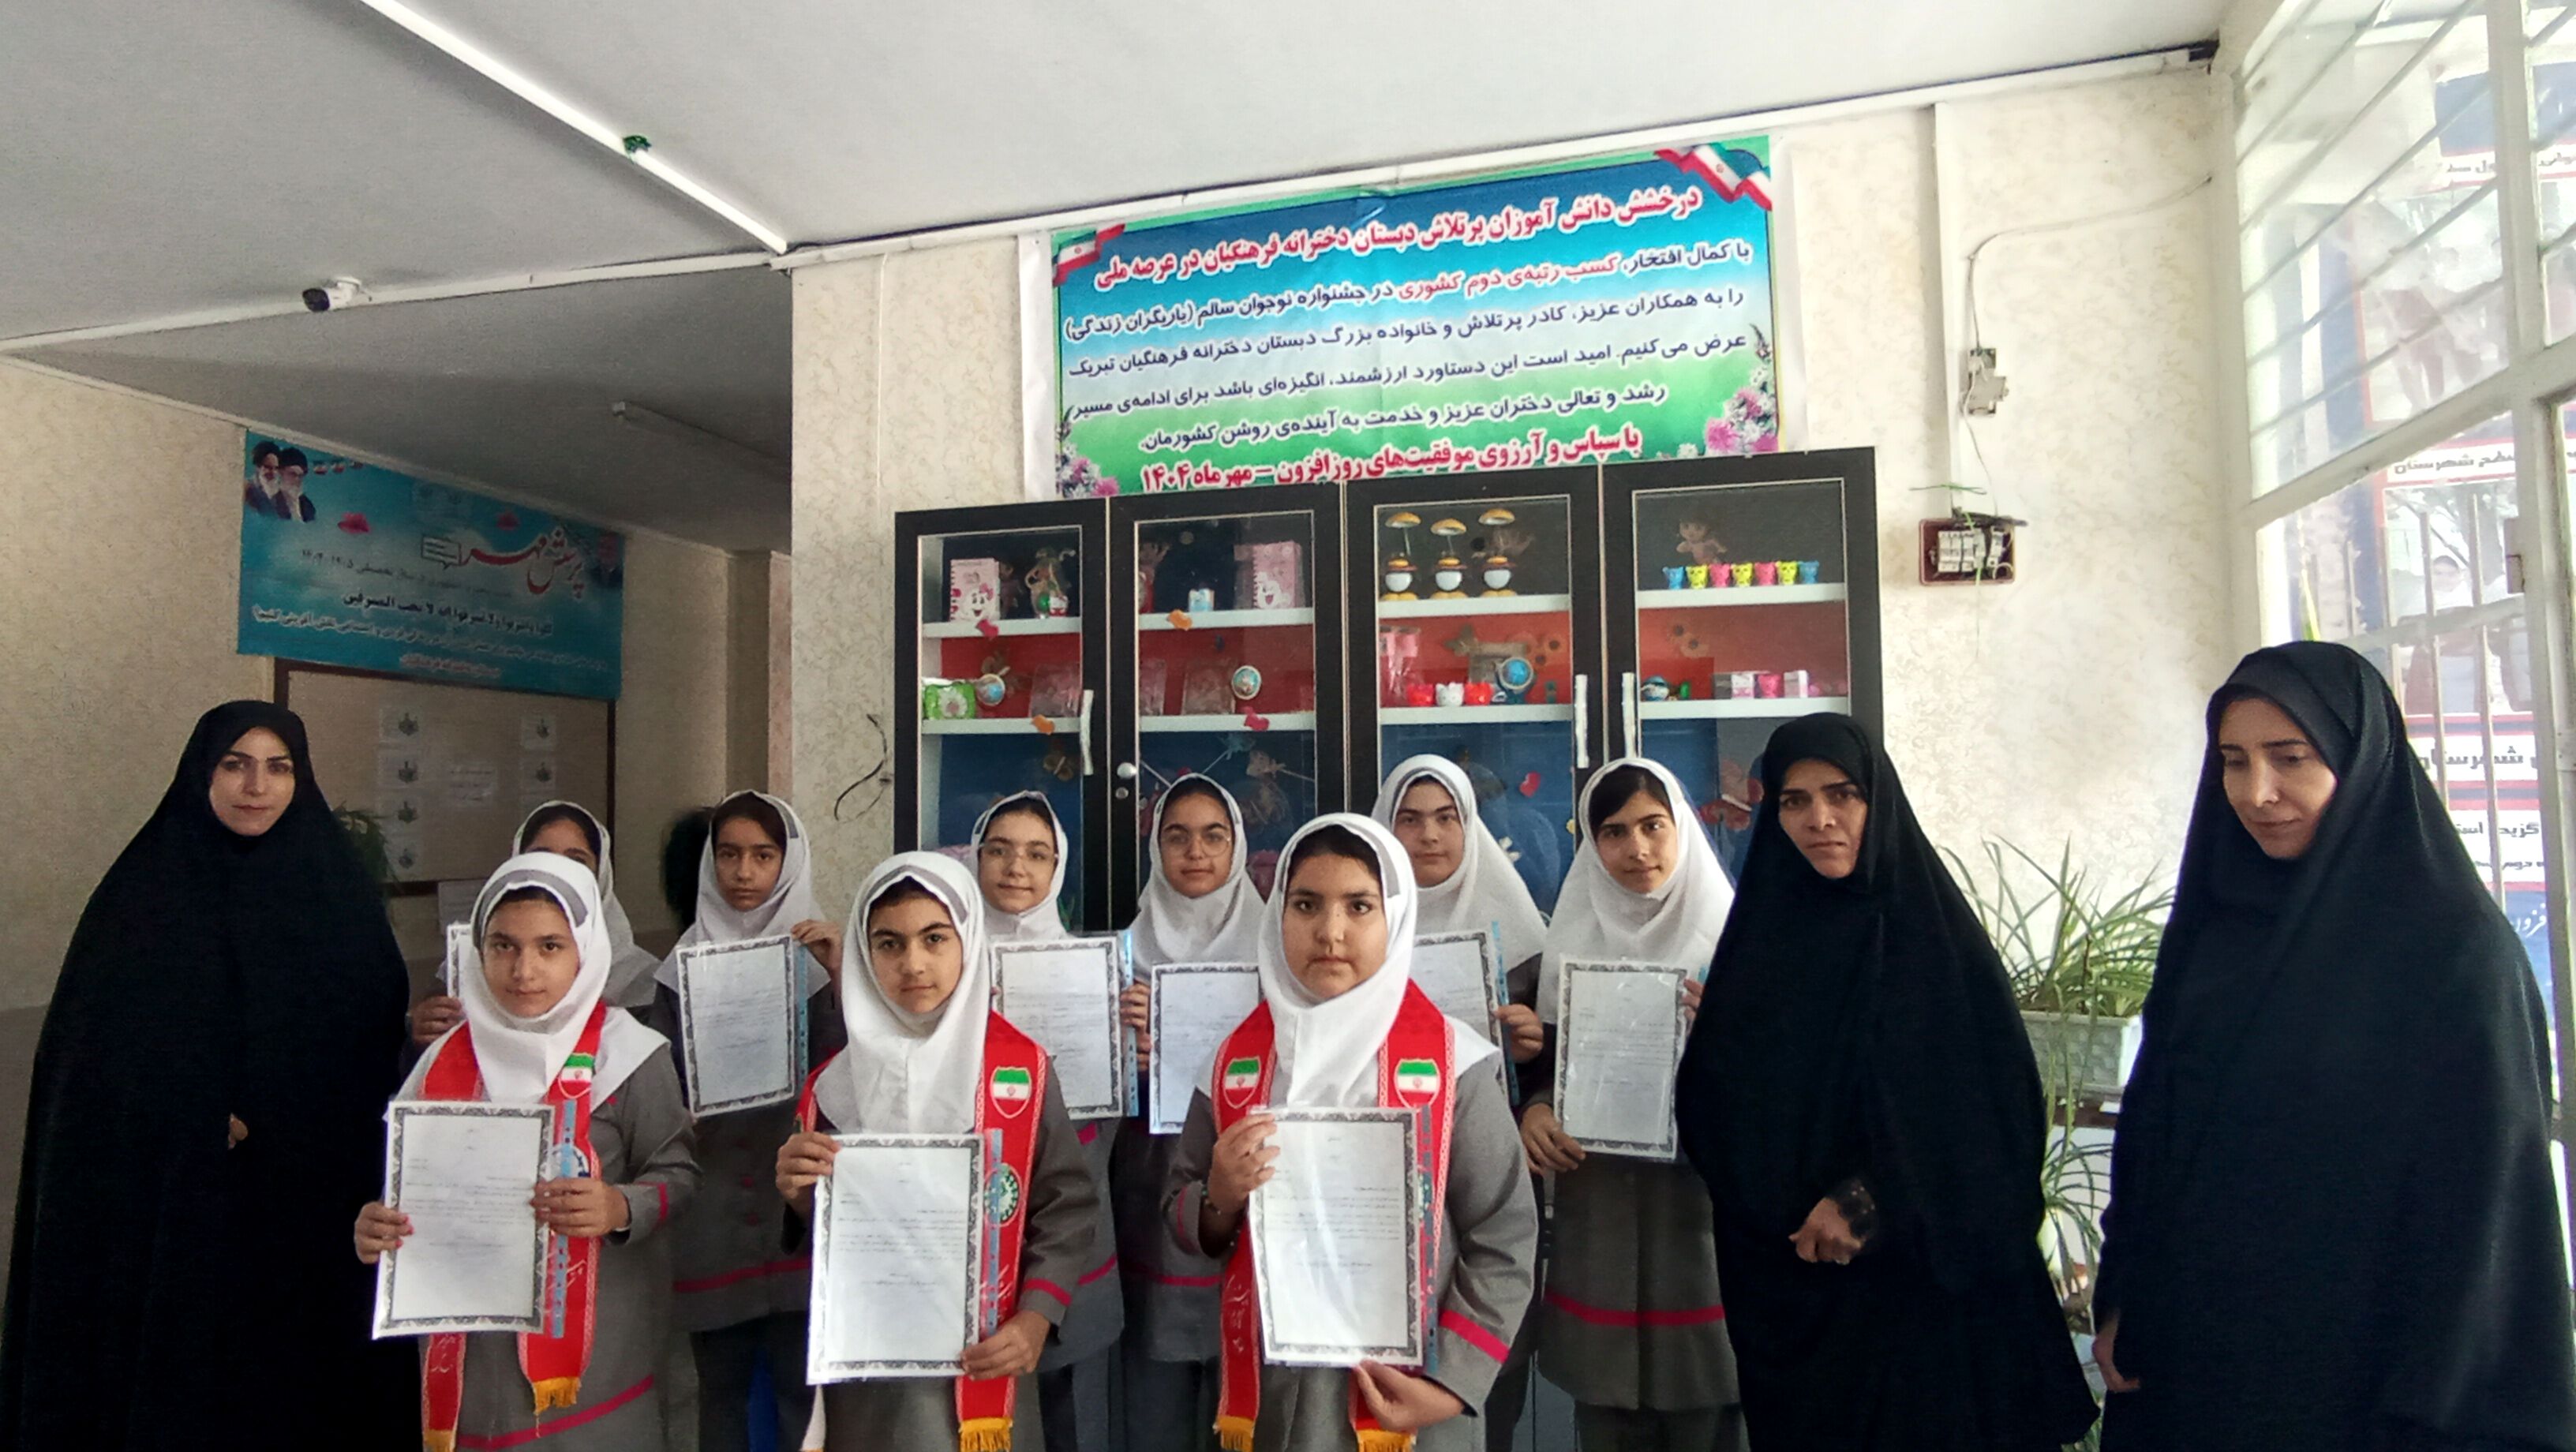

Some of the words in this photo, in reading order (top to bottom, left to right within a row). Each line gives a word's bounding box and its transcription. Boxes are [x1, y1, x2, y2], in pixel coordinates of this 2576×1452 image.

[1561, 197, 1612, 229] دانش
[1619, 189, 1698, 222] درخشش
[1489, 200, 1556, 238] آموزان
[1355, 224, 1415, 251] دبستان
[1421, 217, 1483, 245] پرتلاش
[1284, 226, 1348, 258] دخترانه
[1737, 243, 1749, 261] با
[1204, 235, 1278, 271] فرهنگیان
[1688, 244, 1729, 265] کمال
[1097, 260, 1127, 287] ملی
[1133, 256, 1174, 280] عرصه
[1181, 253, 1199, 276] در
[1567, 257, 1617, 279] کسب
[1372, 285, 1393, 301] در
[1399, 275, 1461, 300] کشوری
[1466, 272, 1500, 296] دوم
[1240, 292, 1291, 315] نوجوان
[1297, 286, 1365, 307] جشنواره
[1625, 293, 1698, 316] همکاران
[1705, 293, 1722, 309] به
[1728, 289, 1743, 305] را
[1199, 304, 1234, 327] سالم
[1458, 313, 1522, 337] پرتلاش
[1528, 306, 1566, 327] کادر
[1322, 327, 1372, 346] بزرگ
[1377, 322, 1436, 342] خانواده
[1443, 324, 1451, 337] و
[1193, 342, 1252, 362] دخترانه
[1257, 332, 1316, 354] دبستان
[1695, 334, 1746, 354] عرض
[1120, 347, 1187, 372] فرهنگیان
[1492, 354, 1517, 376] این
[1524, 350, 1567, 368] است
[1574, 346, 1611, 365] امید
[1069, 357, 1114, 376] تبریک
[1413, 361, 1485, 382] دستاورد
[1175, 387, 1208, 406] برای
[1215, 380, 1252, 397] باشد
[1623, 384, 1664, 402] رشد
[1073, 402, 1112, 419] مسیر
[1491, 396, 1552, 418] دختران
[1559, 393, 1601, 413] تعالی
[1607, 394, 1616, 407] و
[1342, 414, 1359, 431] به
[1365, 409, 1422, 425] خدمت
[1429, 411, 1437, 424] و
[1444, 404, 1484, 423] عزیز
[1222, 421, 1269, 443] روشن
[1625, 425, 1639, 454] با
[1479, 432, 1541, 466] آرزوی
[1549, 444, 1558, 461] و
[1564, 431, 1619, 459] سپاس
[1144, 464, 1189, 489] ۱۴۰۴
